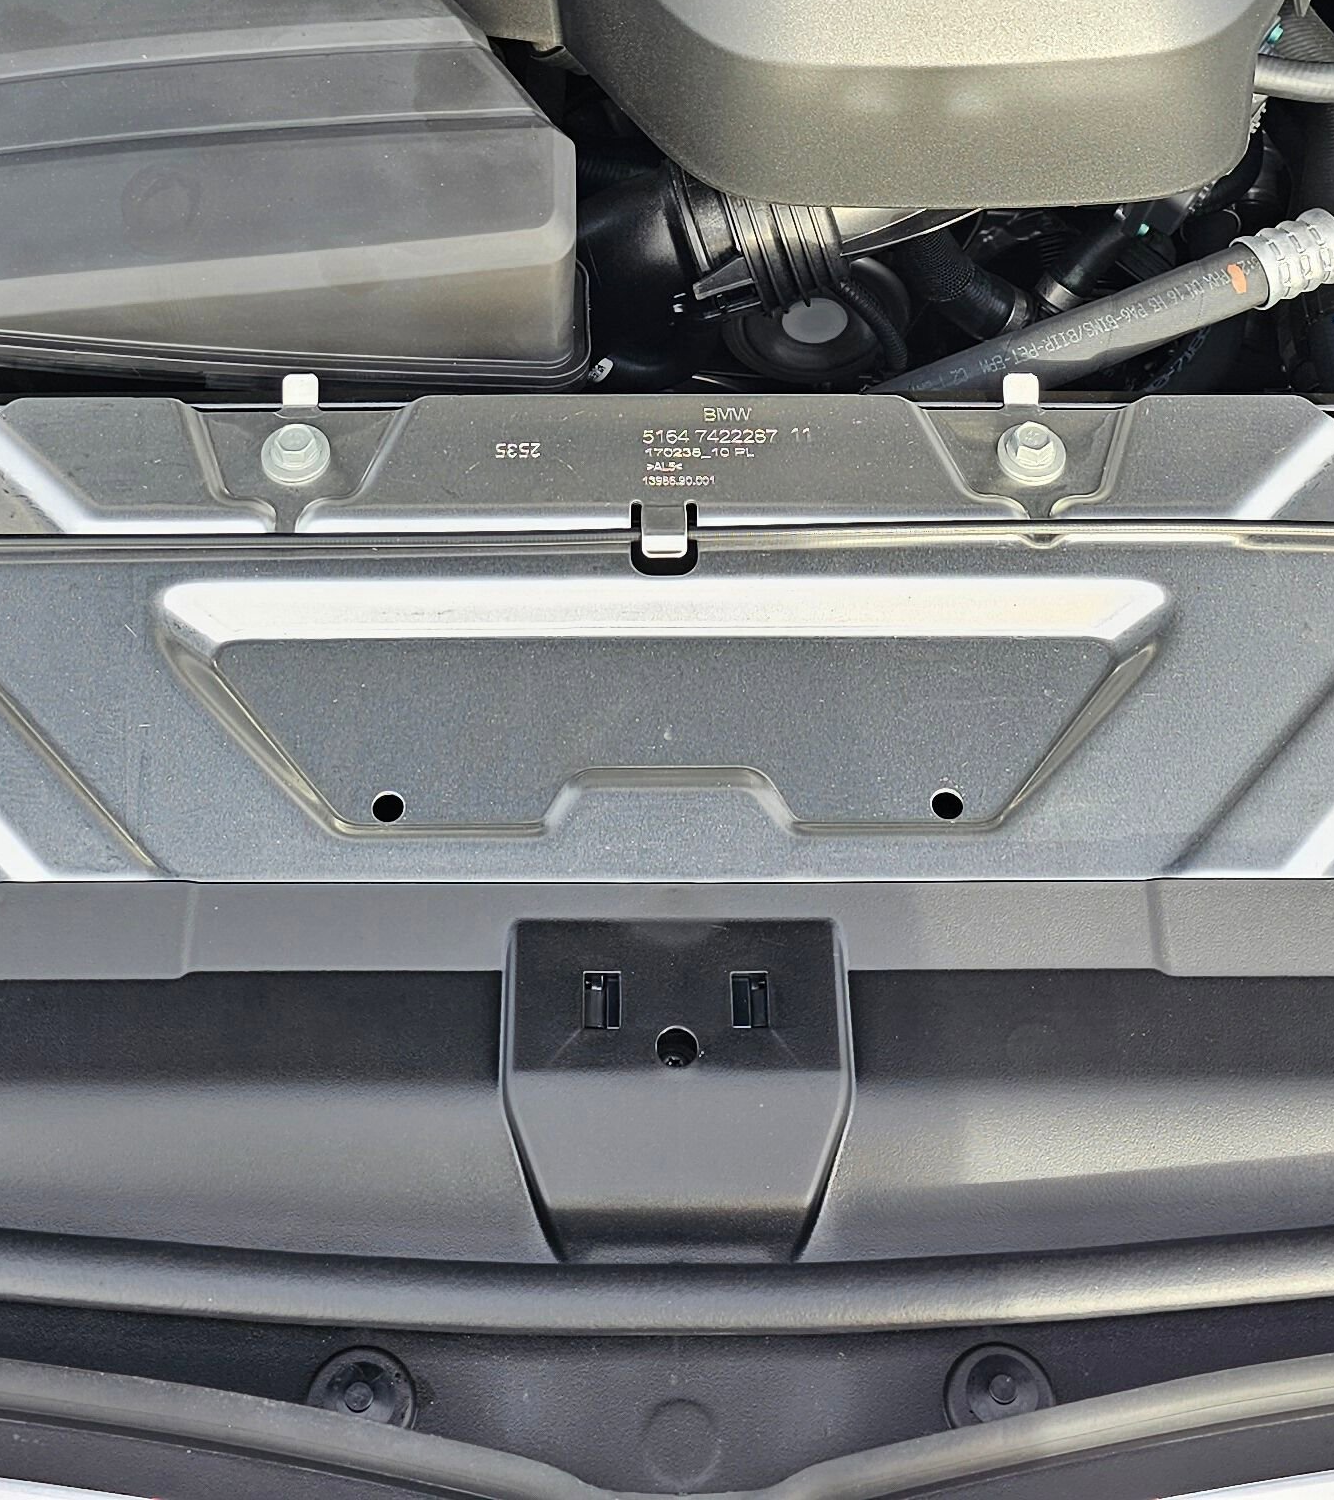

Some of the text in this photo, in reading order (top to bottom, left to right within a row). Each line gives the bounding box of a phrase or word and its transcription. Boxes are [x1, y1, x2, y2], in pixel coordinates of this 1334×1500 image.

[704, 407, 752, 422] BMW
[643, 429, 690, 443] 5164
[694, 429, 779, 443] 7422287
[495, 442, 542, 458] 2535
